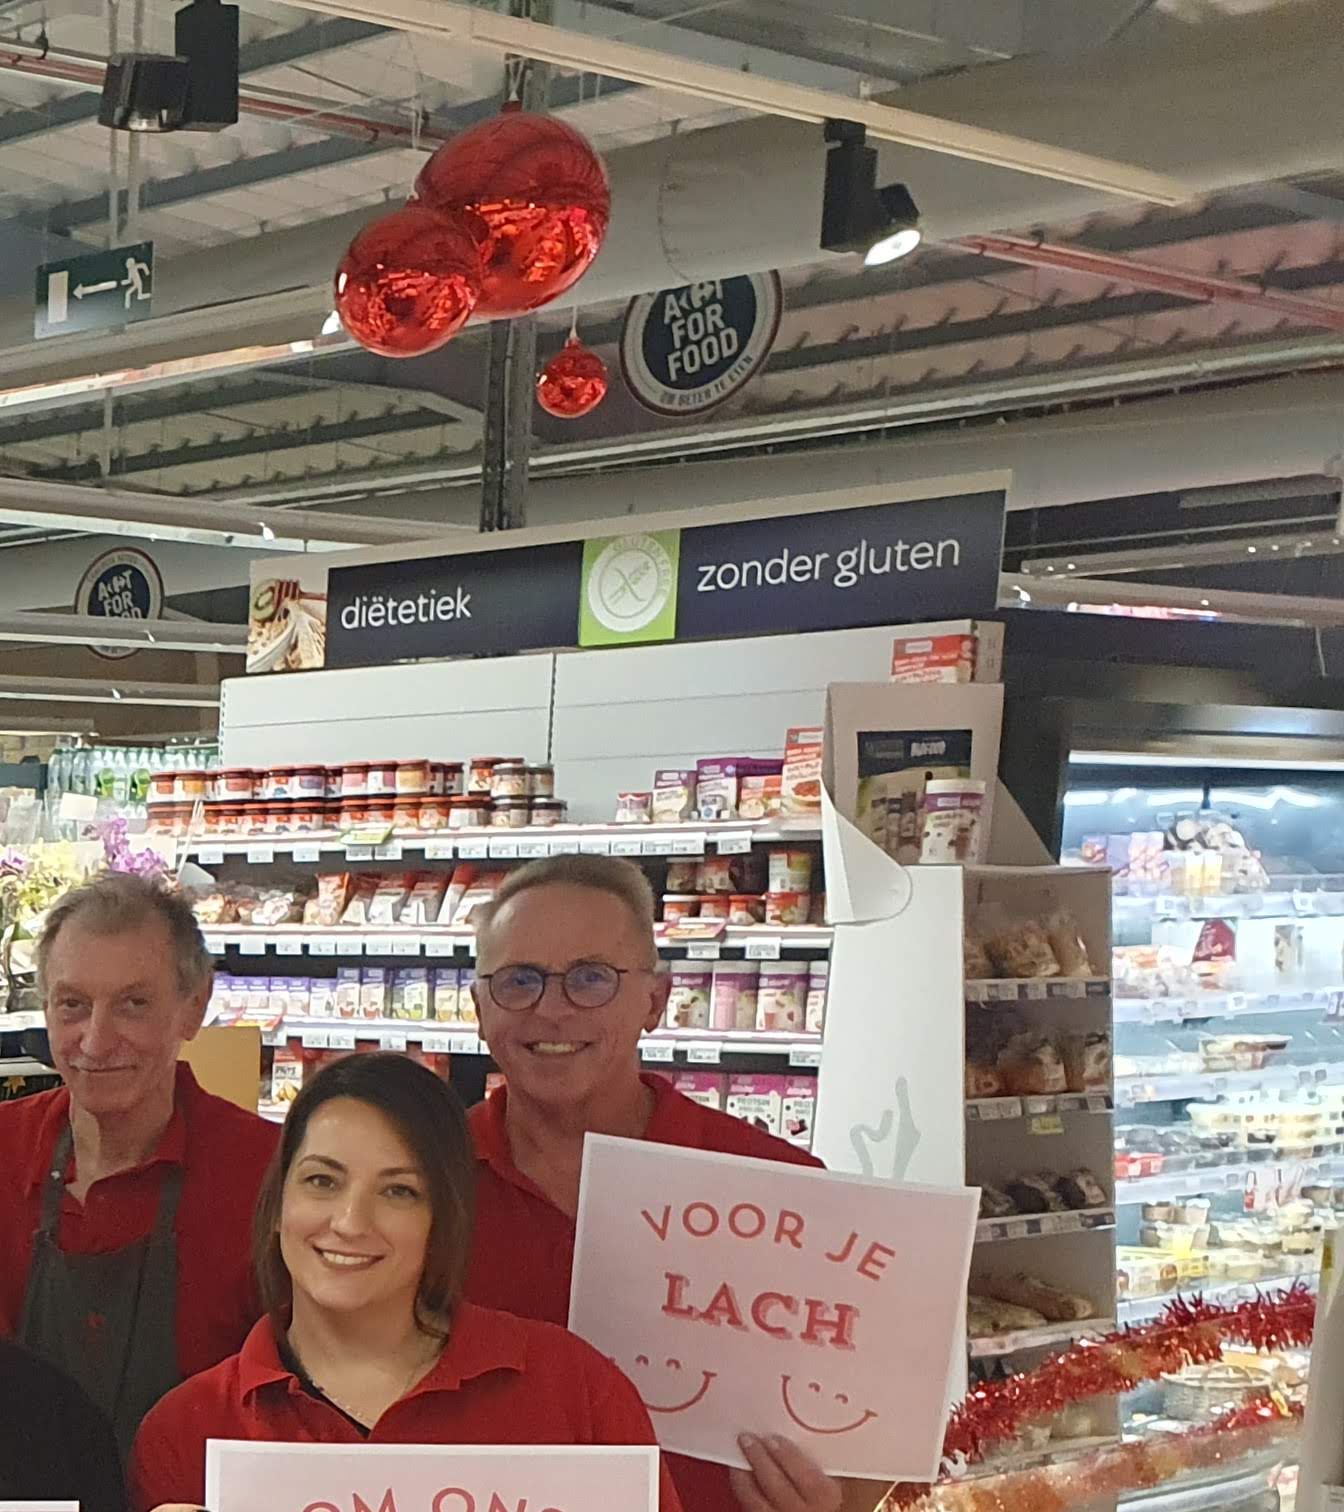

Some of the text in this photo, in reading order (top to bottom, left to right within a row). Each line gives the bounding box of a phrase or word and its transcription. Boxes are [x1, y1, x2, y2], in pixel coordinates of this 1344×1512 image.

[672, 303, 725, 349] FOR
[667, 327, 738, 382] FOOD
[697, 538, 960, 592] zonder gluten
[104, 591, 134, 617] FOR
[341, 586, 472, 630] diëtetiek
[640, 1201, 896, 1281] VOOR JE
[661, 1271, 861, 1352] LACH
